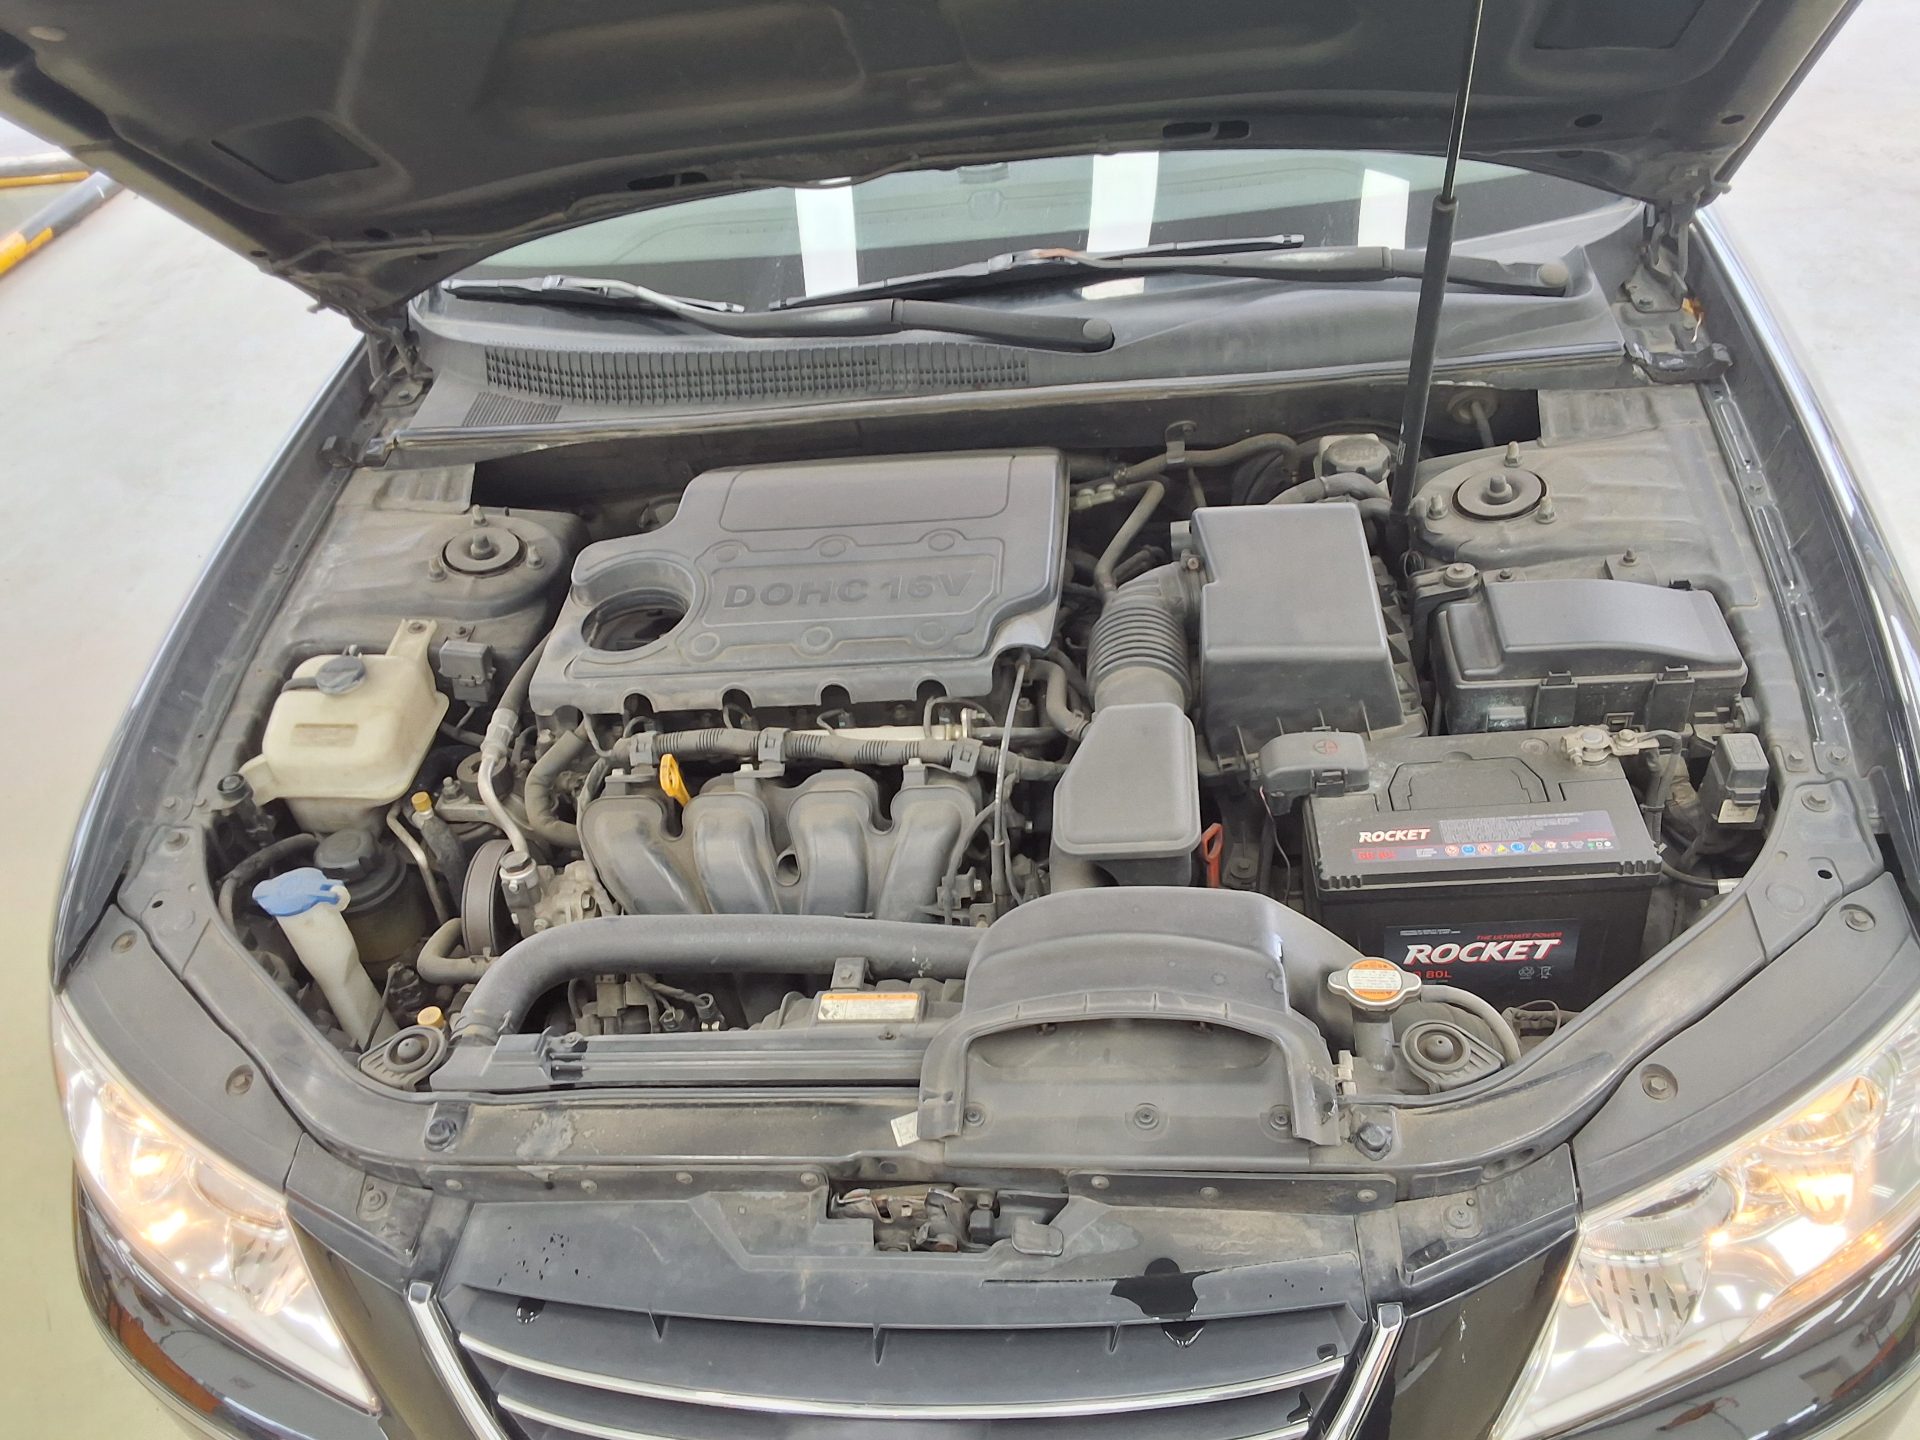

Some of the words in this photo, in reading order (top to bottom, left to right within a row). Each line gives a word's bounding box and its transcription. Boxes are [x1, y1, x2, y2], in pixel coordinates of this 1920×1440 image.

[723, 577, 868, 609] DOHC
[881, 571, 975, 600] 16V
[1359, 828, 1431, 843] ROCKET
[1402, 938, 1562, 965] ROCKET
[1425, 969, 1453, 979] 80L
